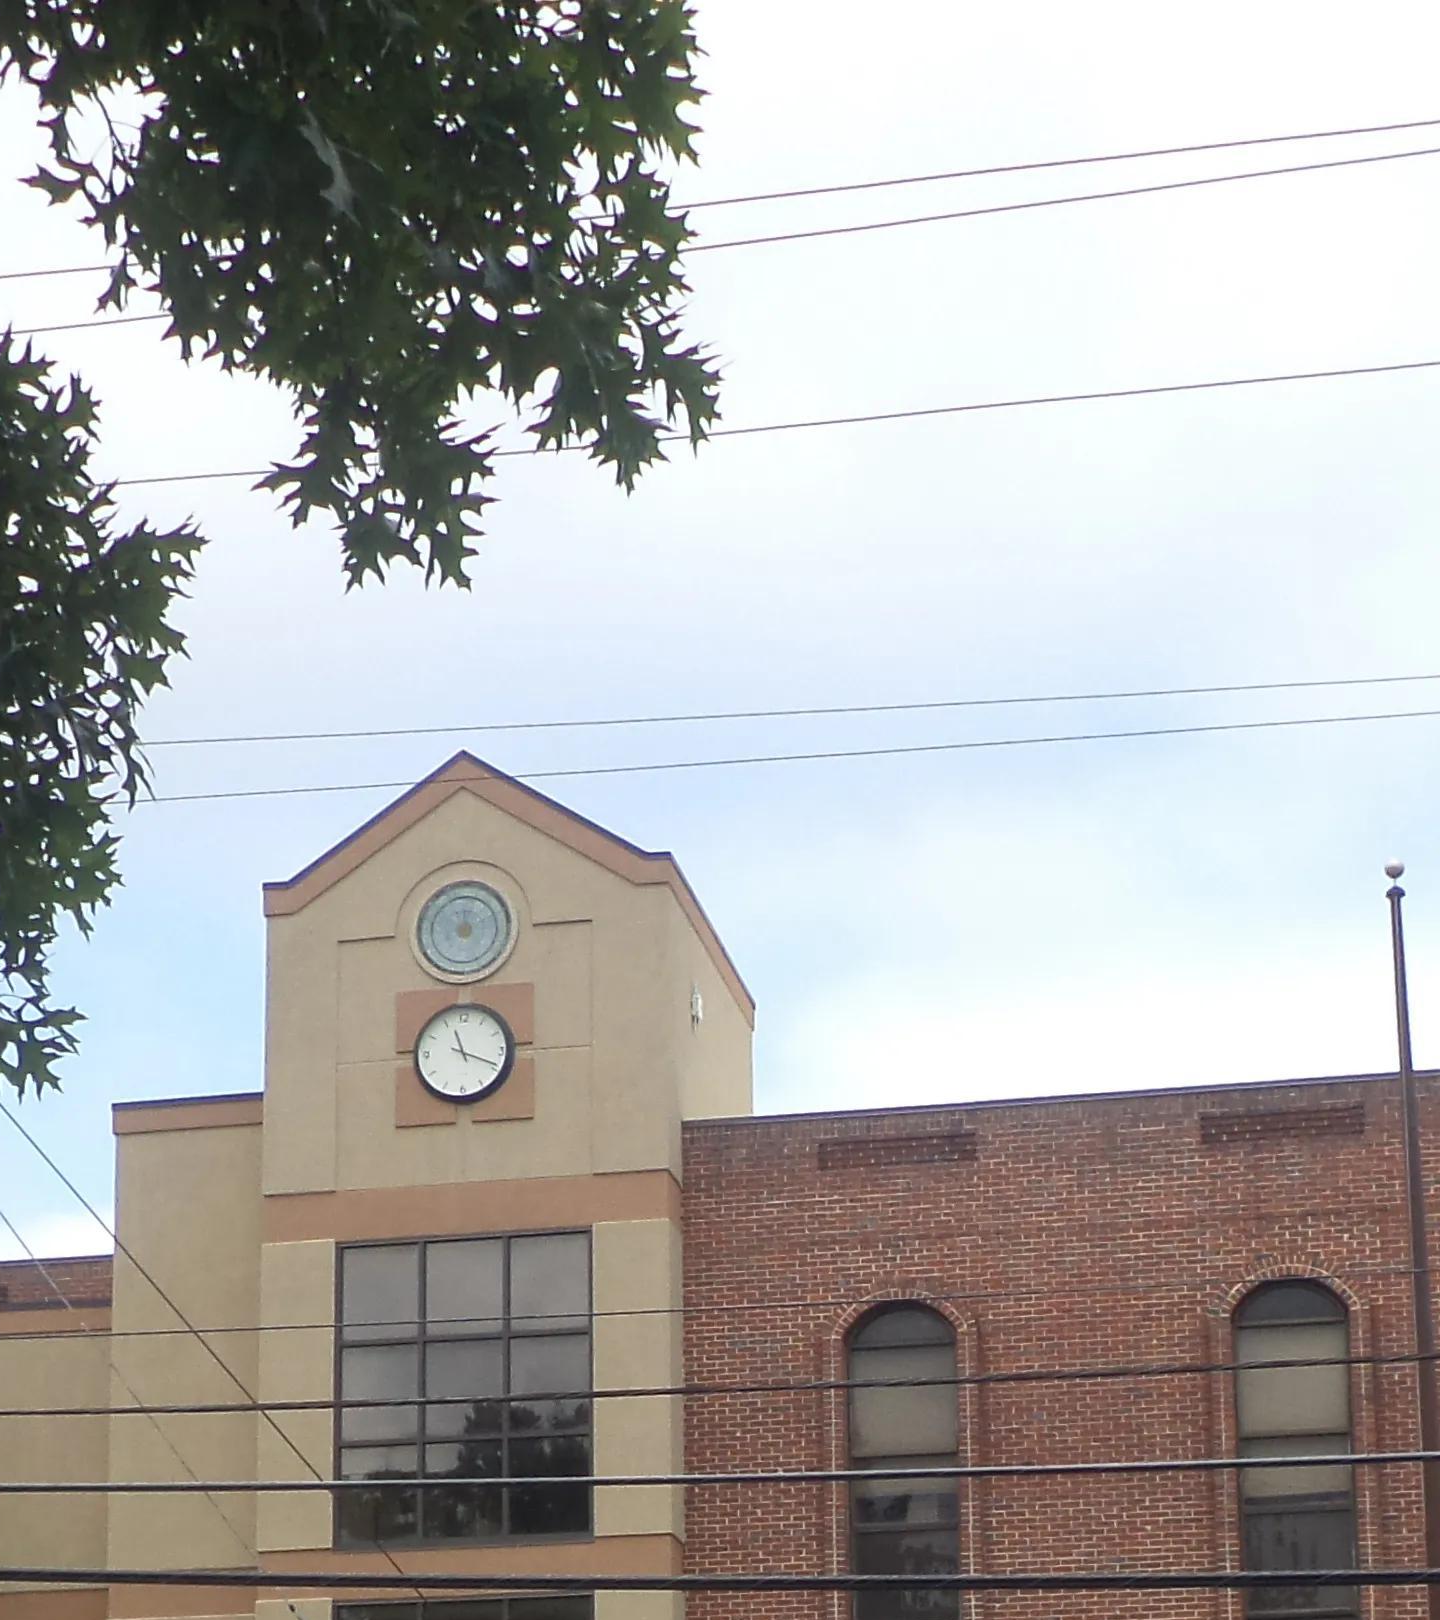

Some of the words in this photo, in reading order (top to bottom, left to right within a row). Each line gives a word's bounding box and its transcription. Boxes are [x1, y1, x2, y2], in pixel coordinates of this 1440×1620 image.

[459, 1013, 470, 1023] 12
[498, 1046, 504, 1056] 3
[460, 1085, 466, 1093] 6
